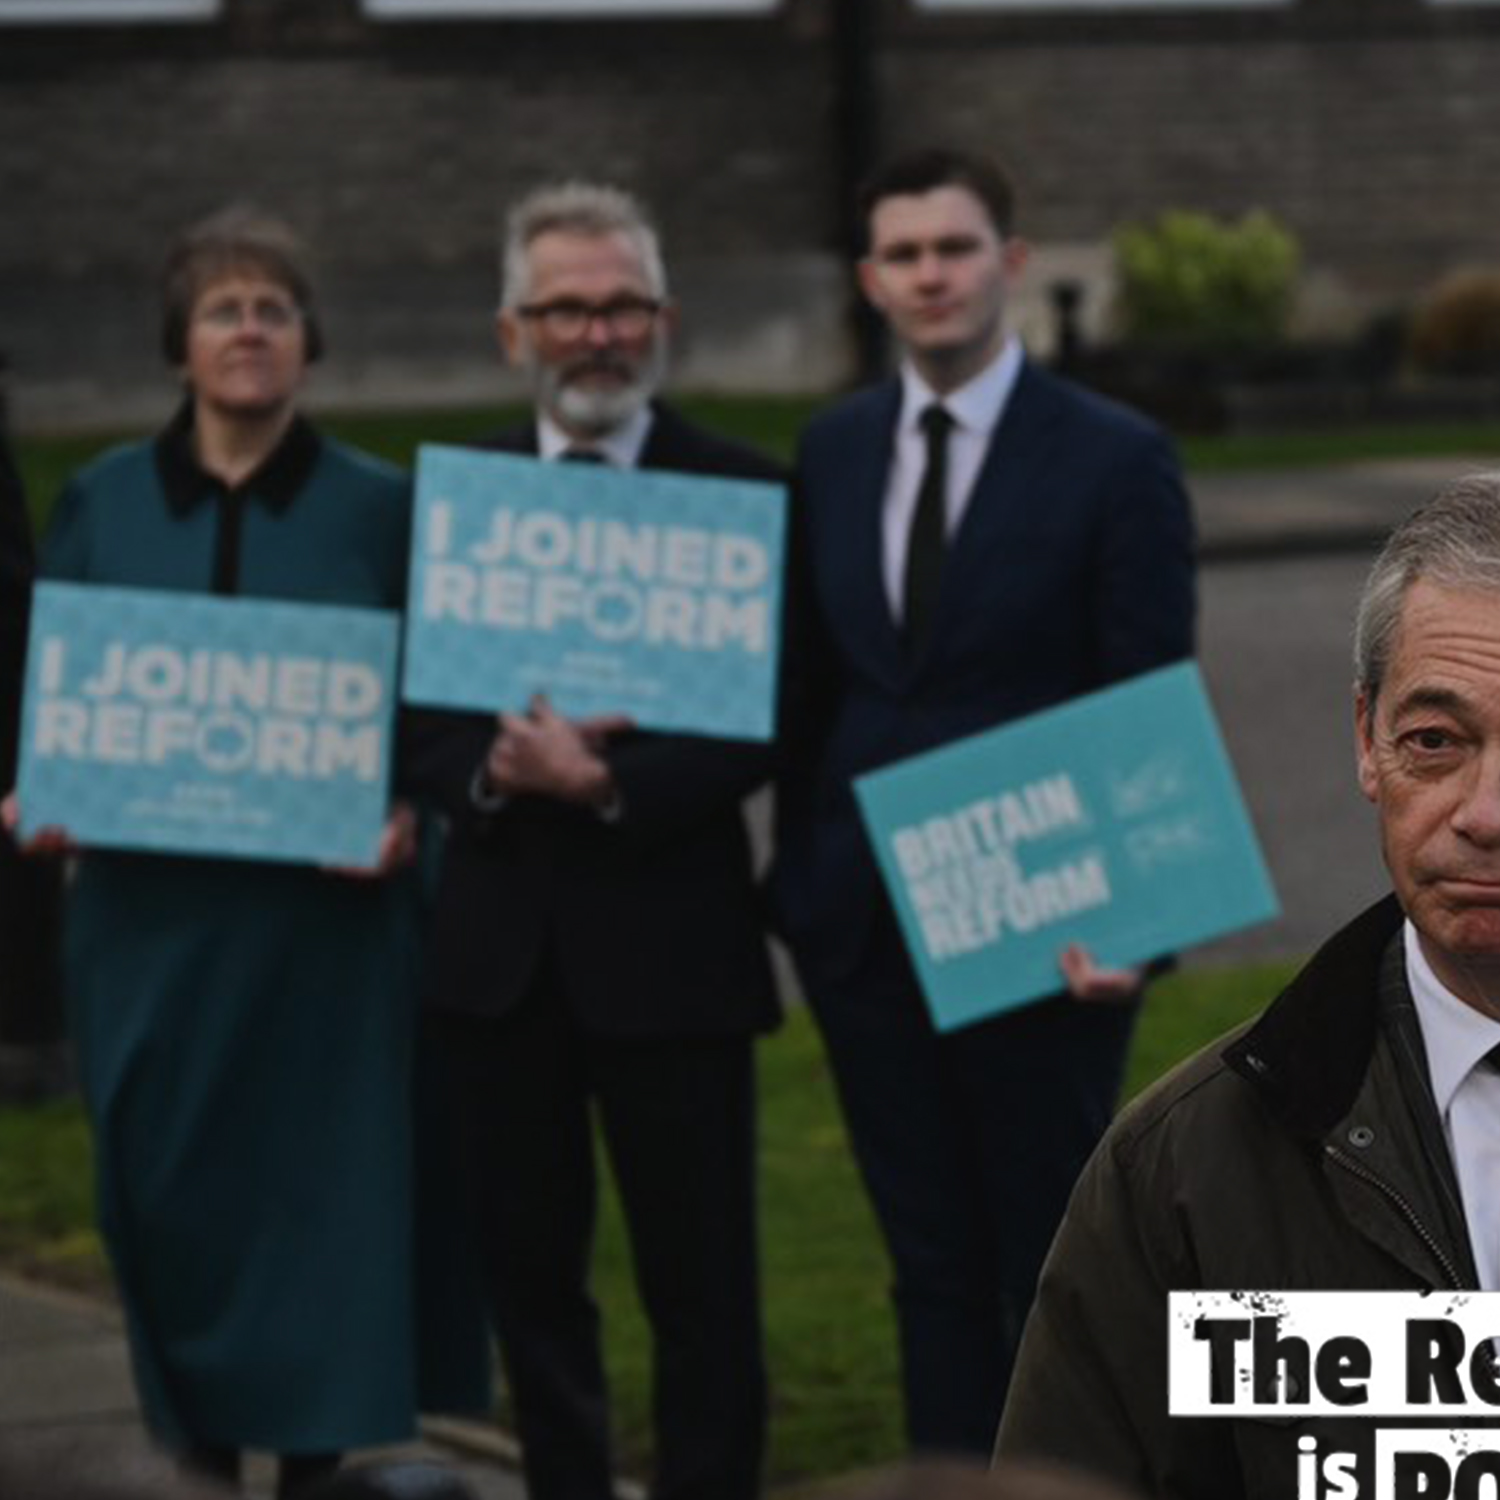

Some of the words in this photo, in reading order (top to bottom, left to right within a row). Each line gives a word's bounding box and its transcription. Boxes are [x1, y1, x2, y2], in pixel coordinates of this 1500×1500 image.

[427, 501, 450, 559] I
[471, 509, 768, 587] JOINED
[423, 562, 767, 652] REFORM
[39, 636, 66, 695] I
[83, 643, 382, 719] JOINED
[34, 701, 380, 782] REFORM
[892, 774, 1082, 881] BRITAIN
[916, 852, 1112, 962] REFORM
